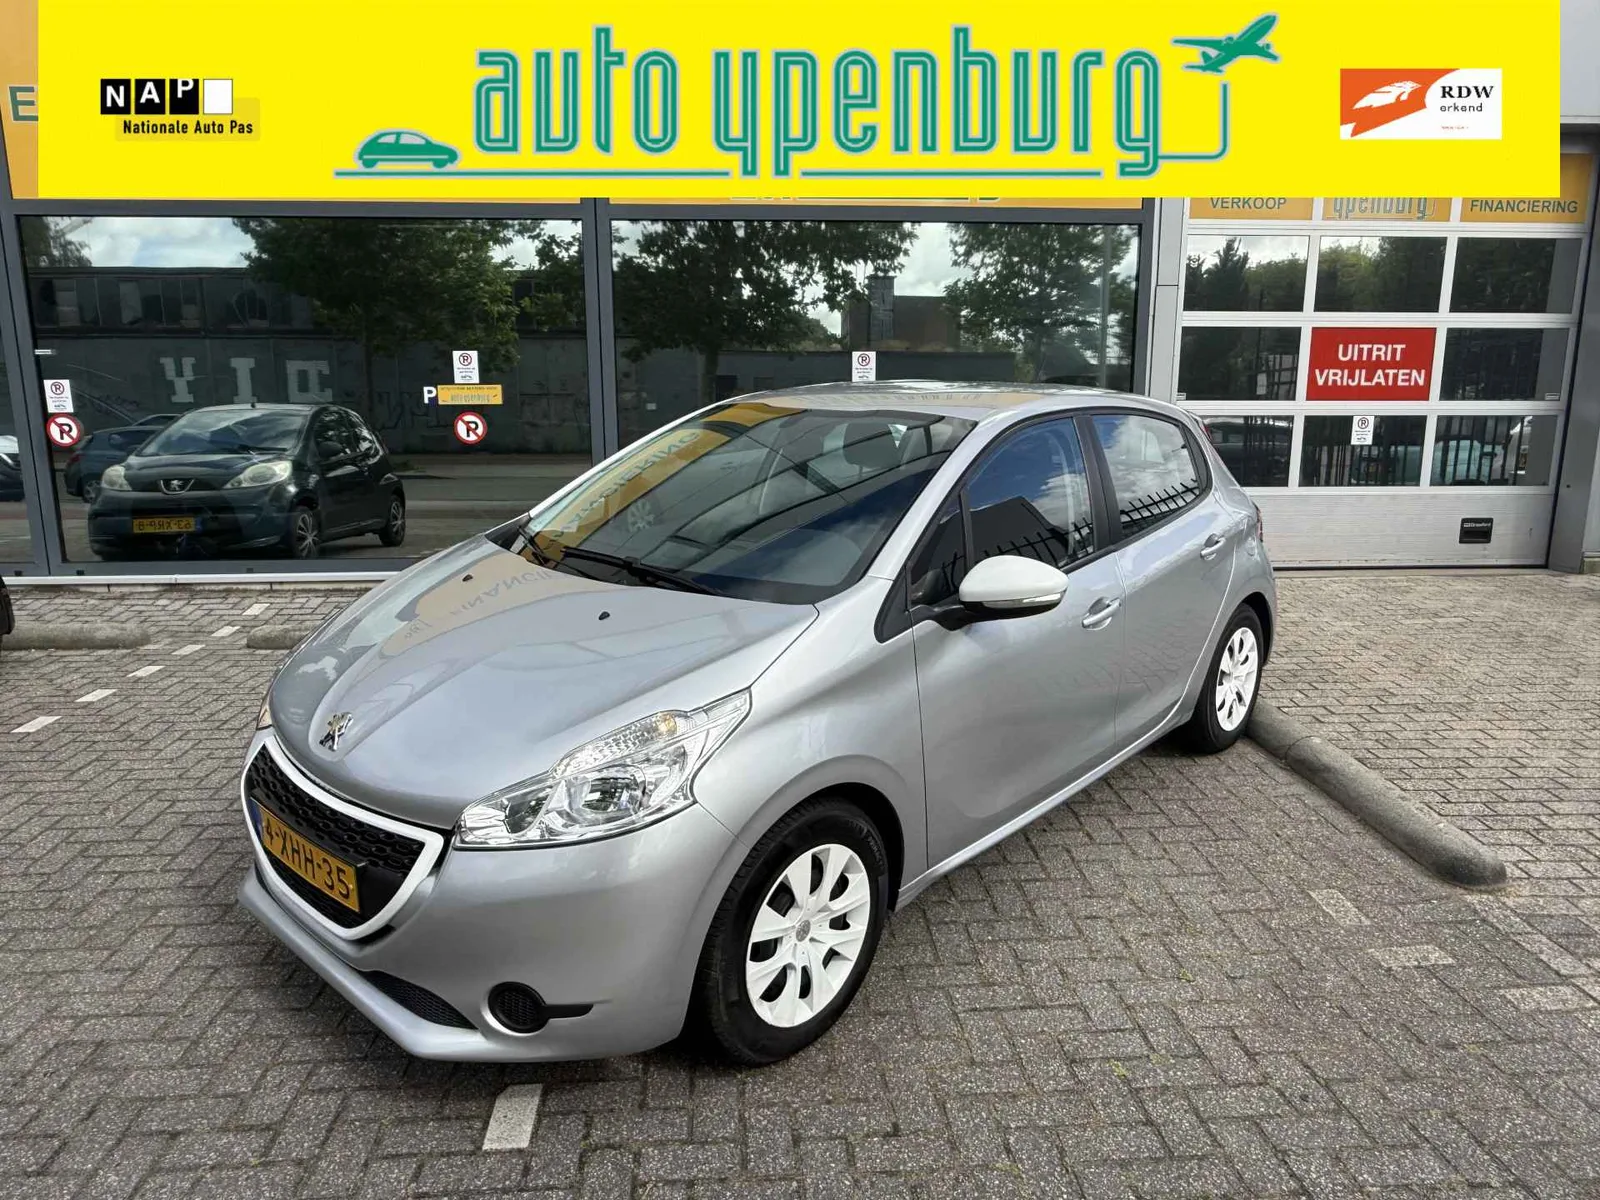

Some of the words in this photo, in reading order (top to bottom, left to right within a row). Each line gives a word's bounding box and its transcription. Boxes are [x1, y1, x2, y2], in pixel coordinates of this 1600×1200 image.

[1210, 197, 1287, 210] VERKOOP
[1470, 199, 1579, 214] FINANCIERING
[1338, 344, 1406, 362] UITRIT
[1315, 369, 1425, 387] VRIJLATEN
[264, 817, 350, 901] 4-XHH-35
